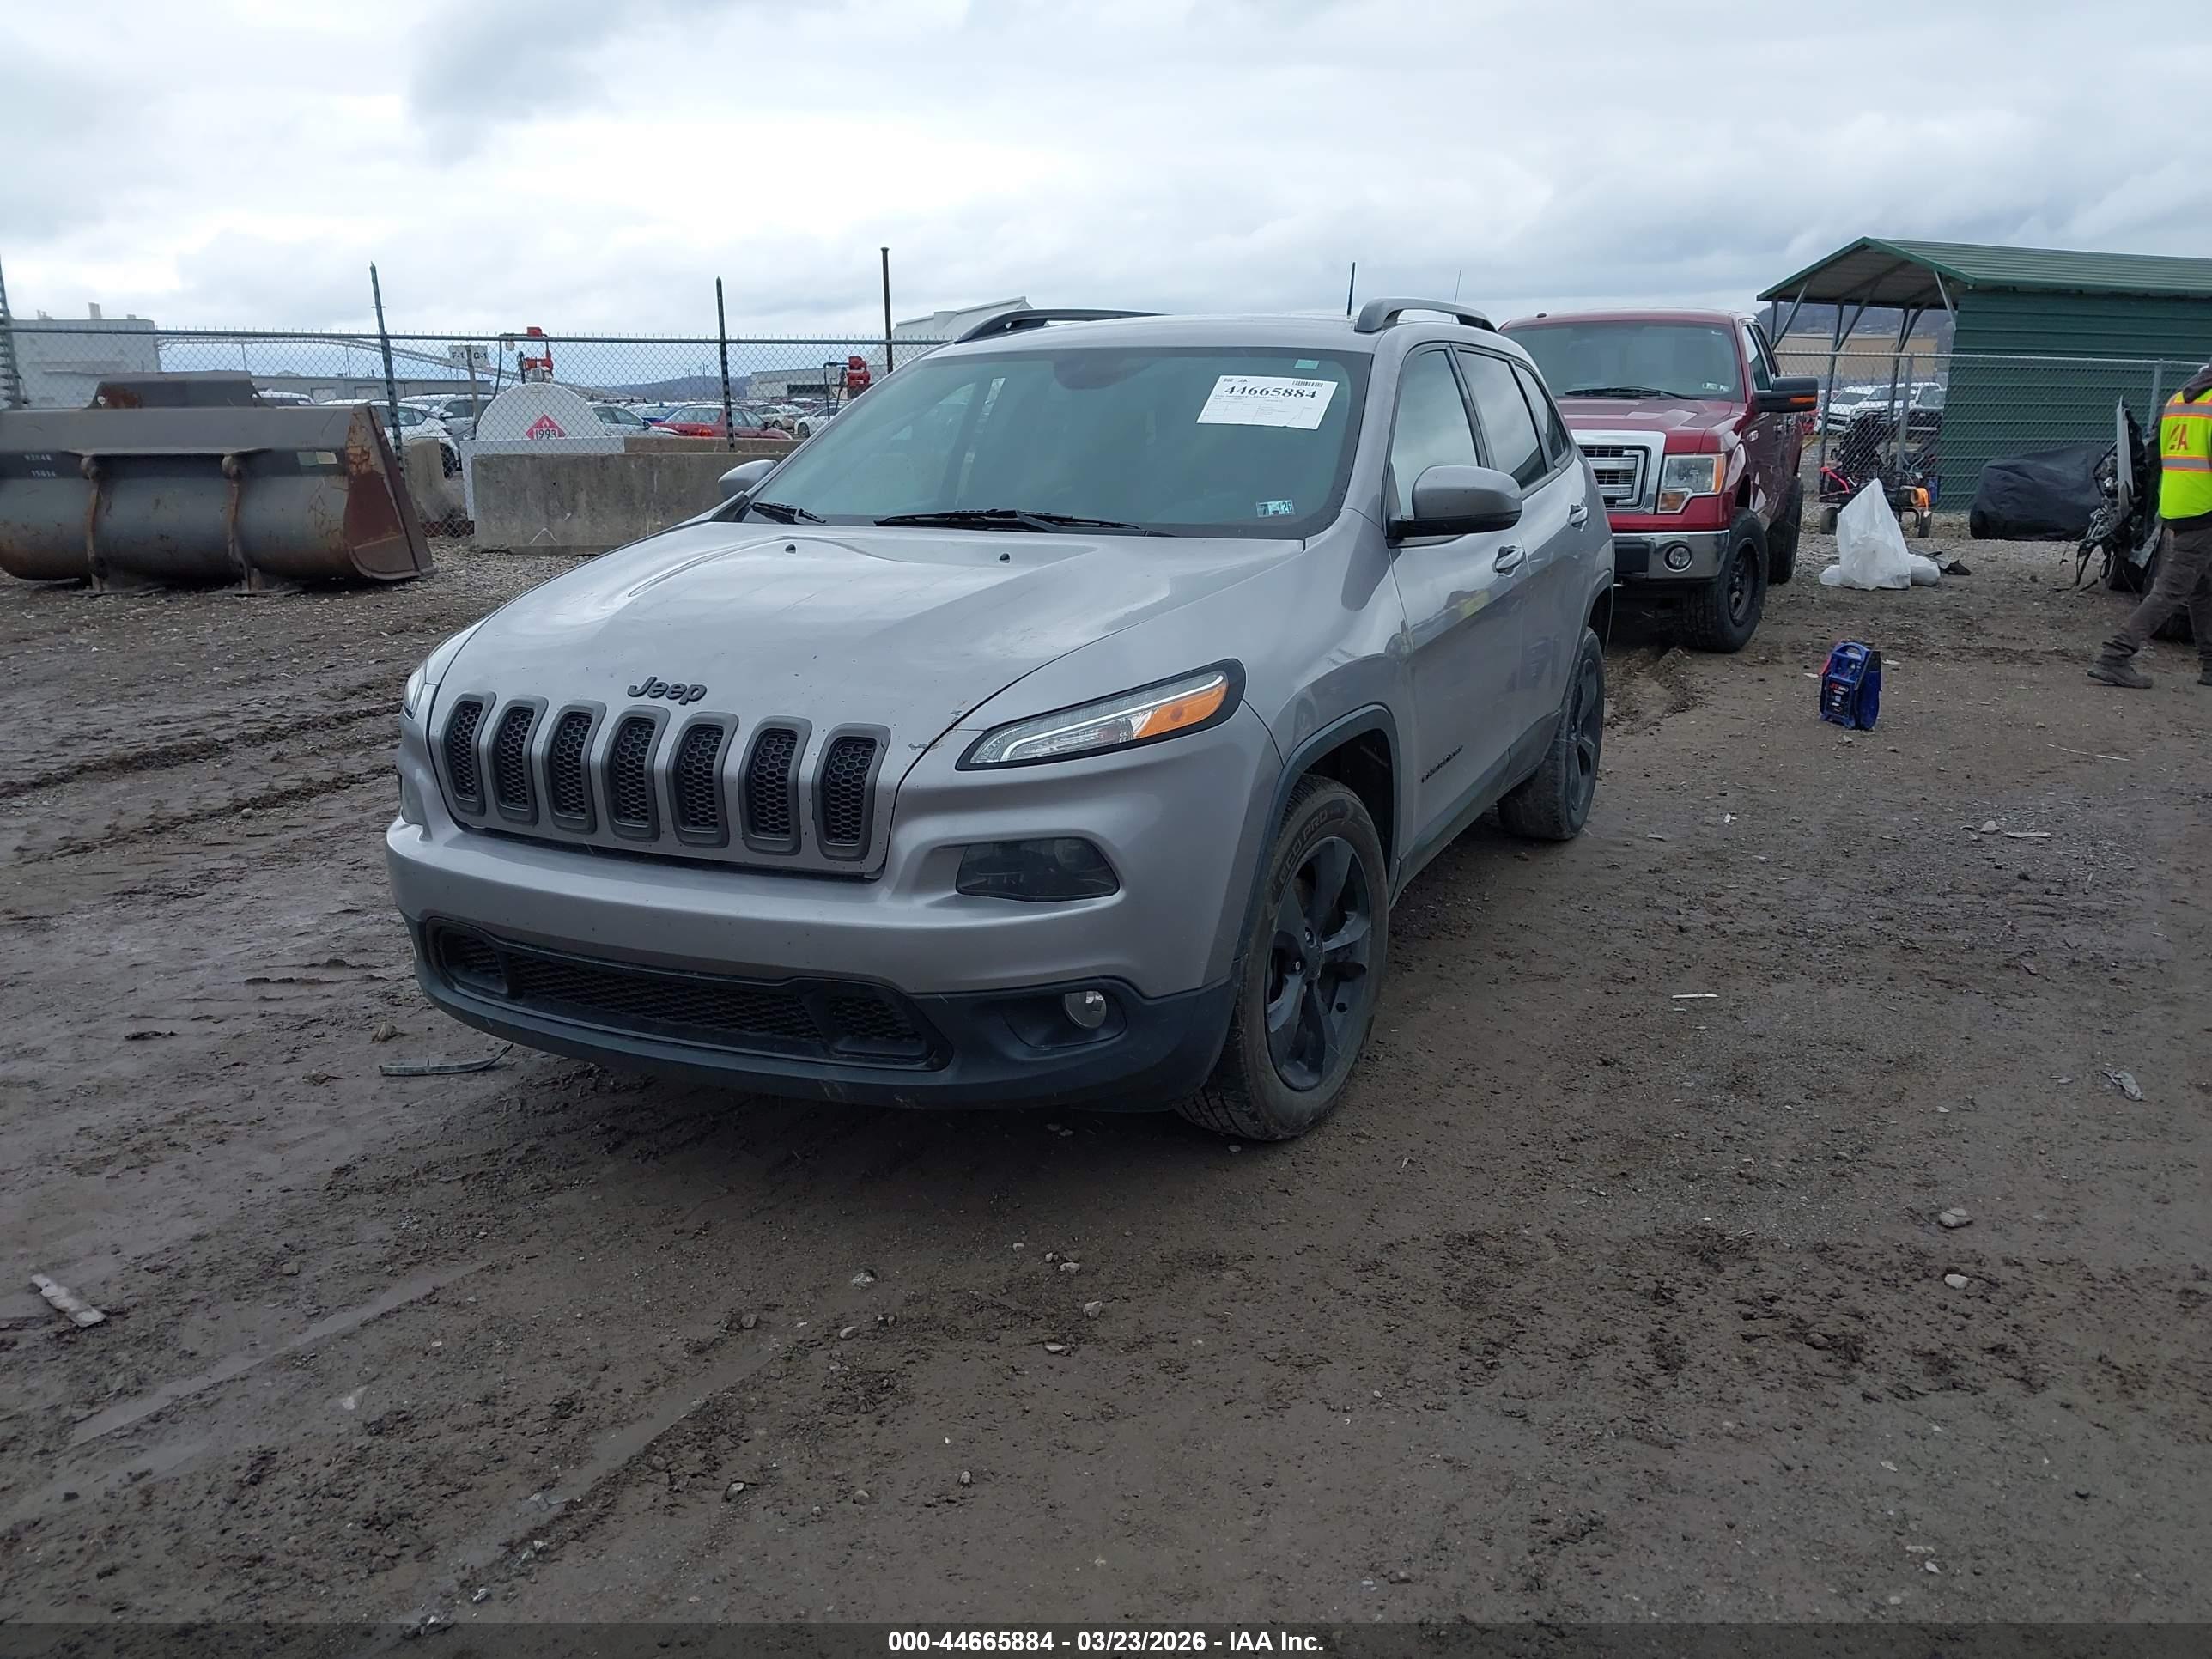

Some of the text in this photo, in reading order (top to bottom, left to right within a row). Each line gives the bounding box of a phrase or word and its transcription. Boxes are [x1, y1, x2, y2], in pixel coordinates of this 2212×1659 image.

[1224, 386, 1317, 399] 44665884
[535, 428, 557, 441] 1993
[627, 676, 708, 706] Jeep
